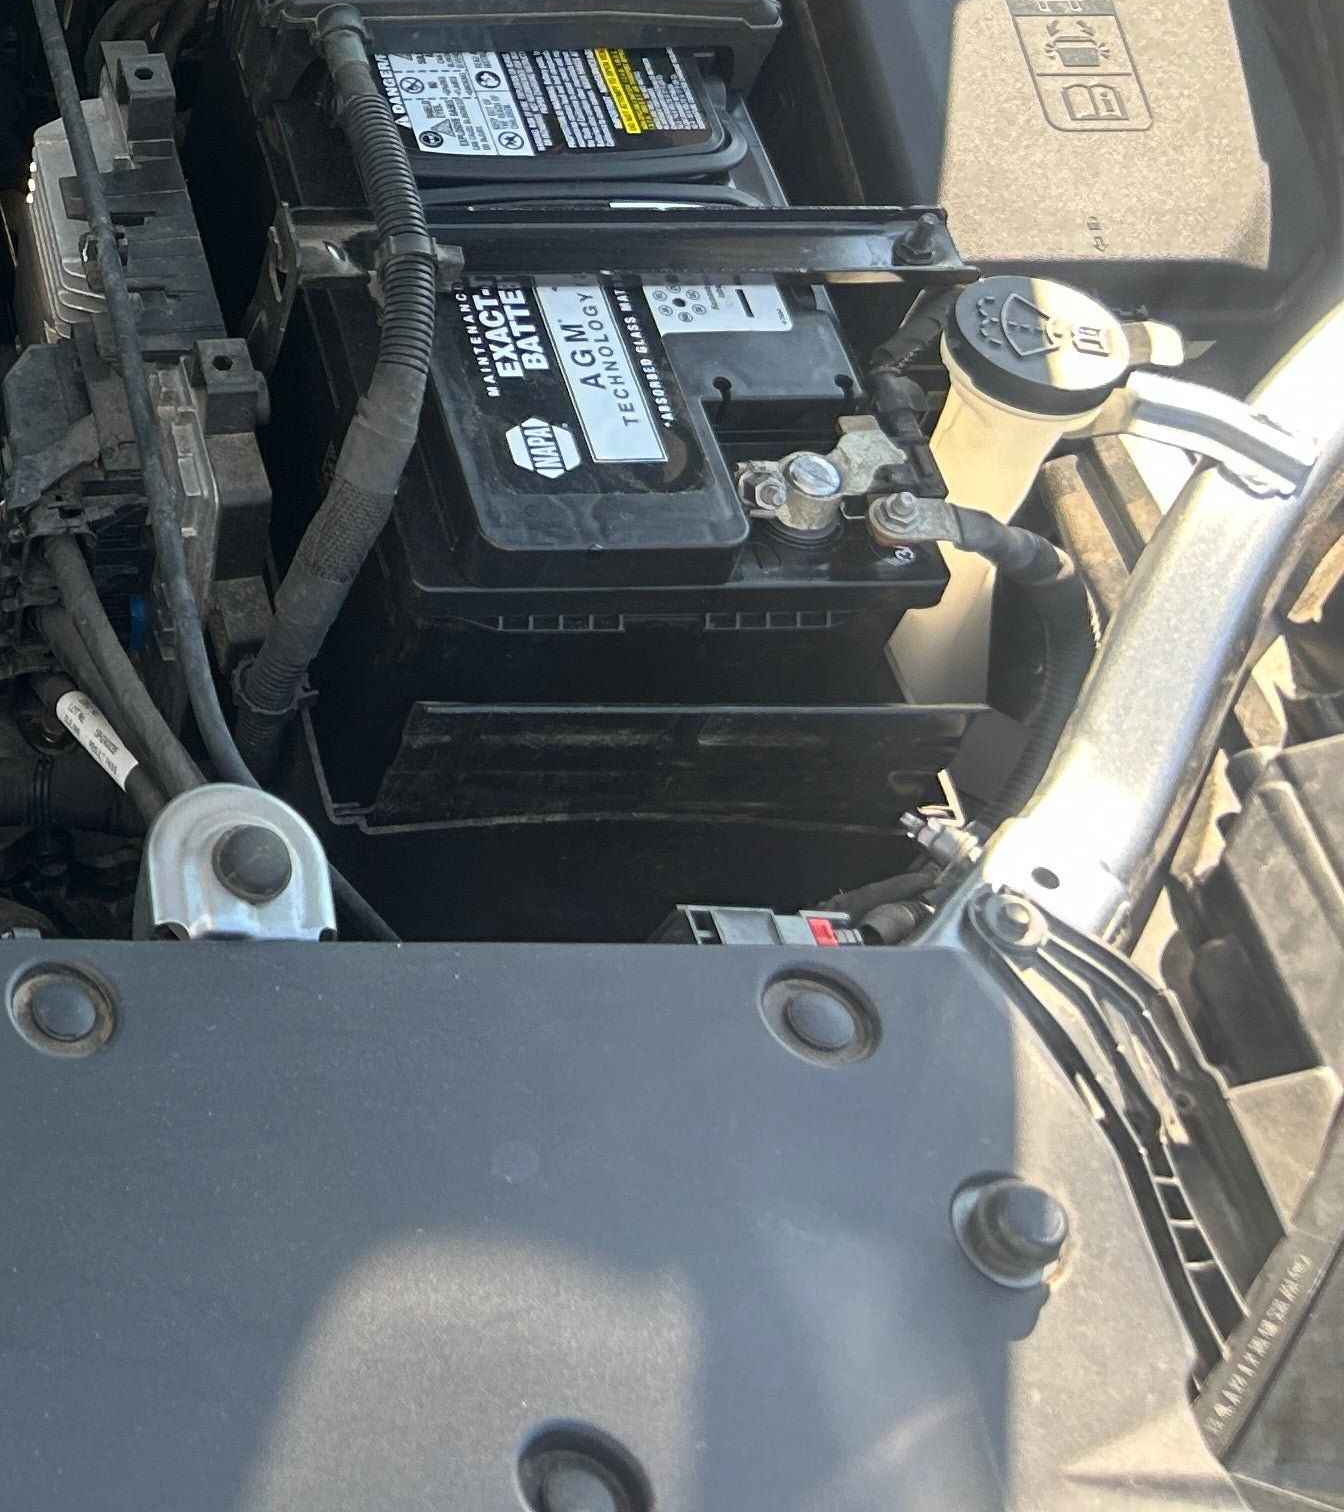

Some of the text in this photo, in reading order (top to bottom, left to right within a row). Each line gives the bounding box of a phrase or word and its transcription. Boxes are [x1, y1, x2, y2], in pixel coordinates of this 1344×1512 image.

[560, 323, 607, 390] AGM
[577, 292, 640, 427] TECHNOLOGY
[624, 316, 649, 354] GLASS
[523, 426, 564, 469] NAPA
